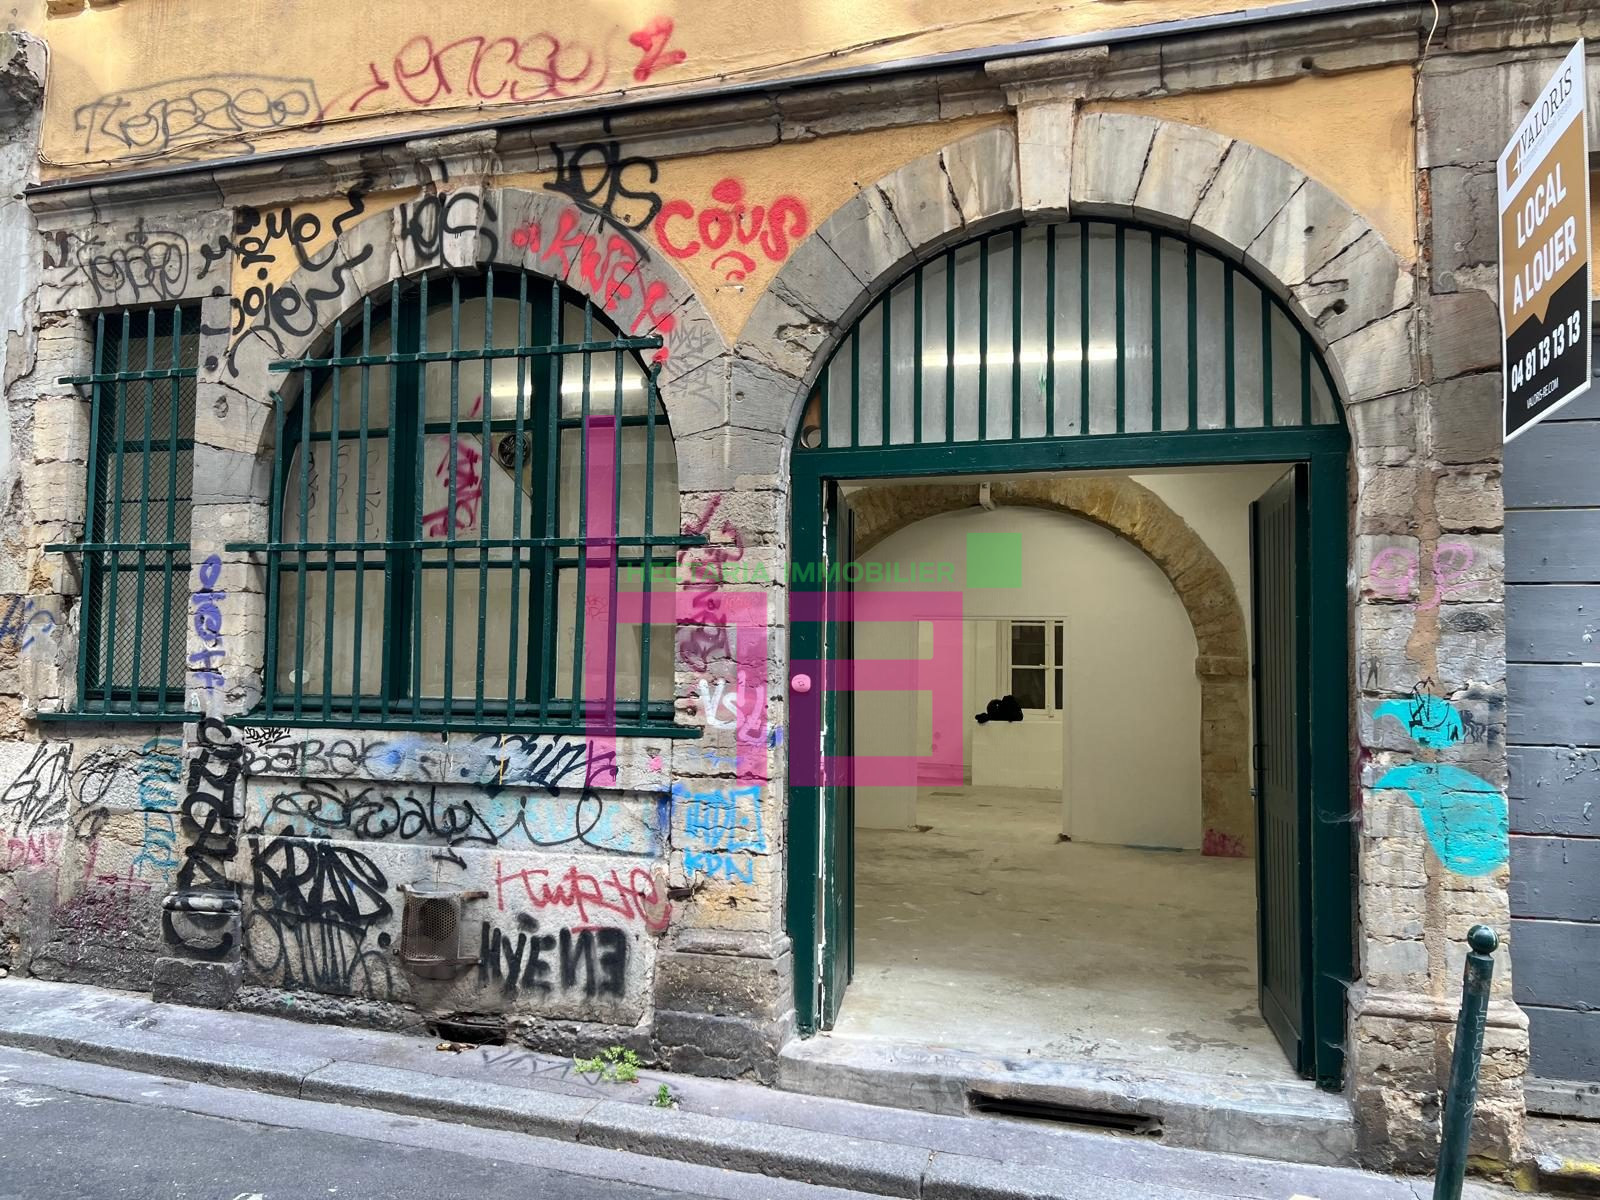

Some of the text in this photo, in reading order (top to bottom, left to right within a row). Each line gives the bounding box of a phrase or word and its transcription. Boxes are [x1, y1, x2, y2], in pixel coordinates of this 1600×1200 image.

[1520, 65, 1574, 155] VALORIS
[1516, 162, 1567, 249] LOCAL
[1513, 215, 1577, 315] A LOUER
[1511, 309, 1580, 393] 04 81 13 13 13
